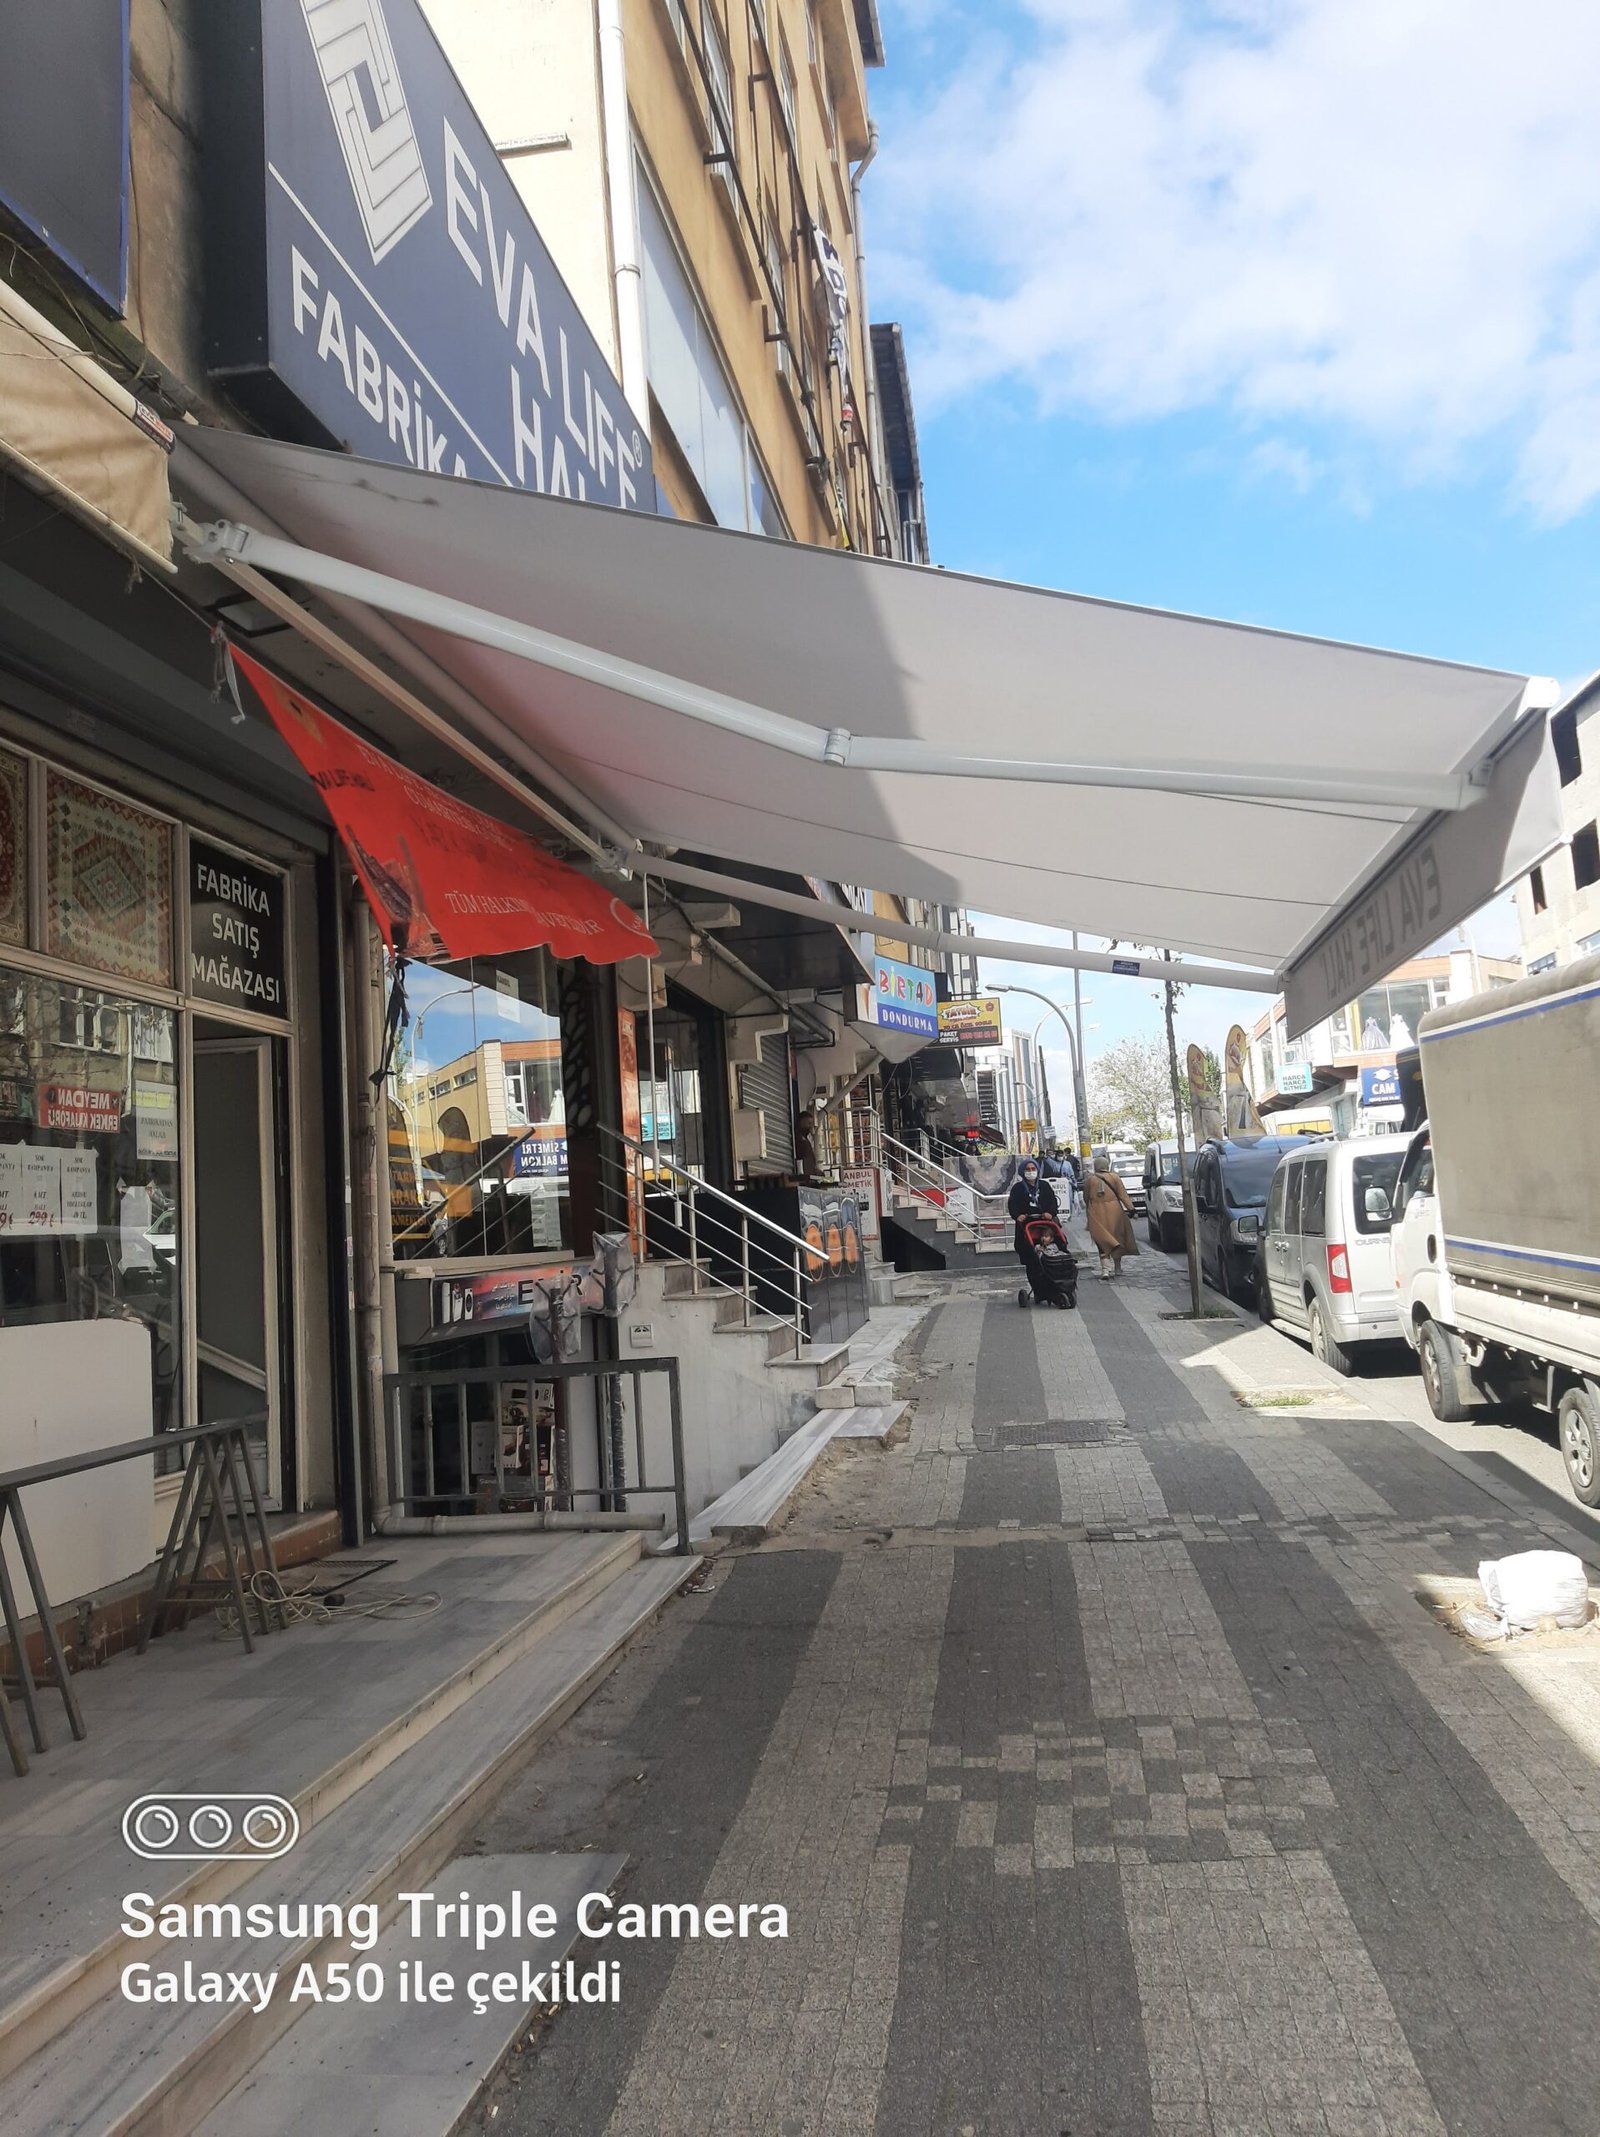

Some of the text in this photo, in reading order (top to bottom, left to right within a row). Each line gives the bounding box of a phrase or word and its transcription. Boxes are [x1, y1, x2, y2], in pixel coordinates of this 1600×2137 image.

[443, 116, 552, 398] EVA
[197, 864, 271, 917] FABRİKA
[444, 890, 481, 914] TÜM
[212, 912, 260, 959] SATIŞ
[191, 953, 280, 1004] MAĞAZASI
[879, 966, 933, 1007] BİRTAD
[882, 1009, 933, 1032] DONDURMA
[1371, 1082, 1396, 1095] CAM
[844, 1171, 872, 1180] ANBUL
